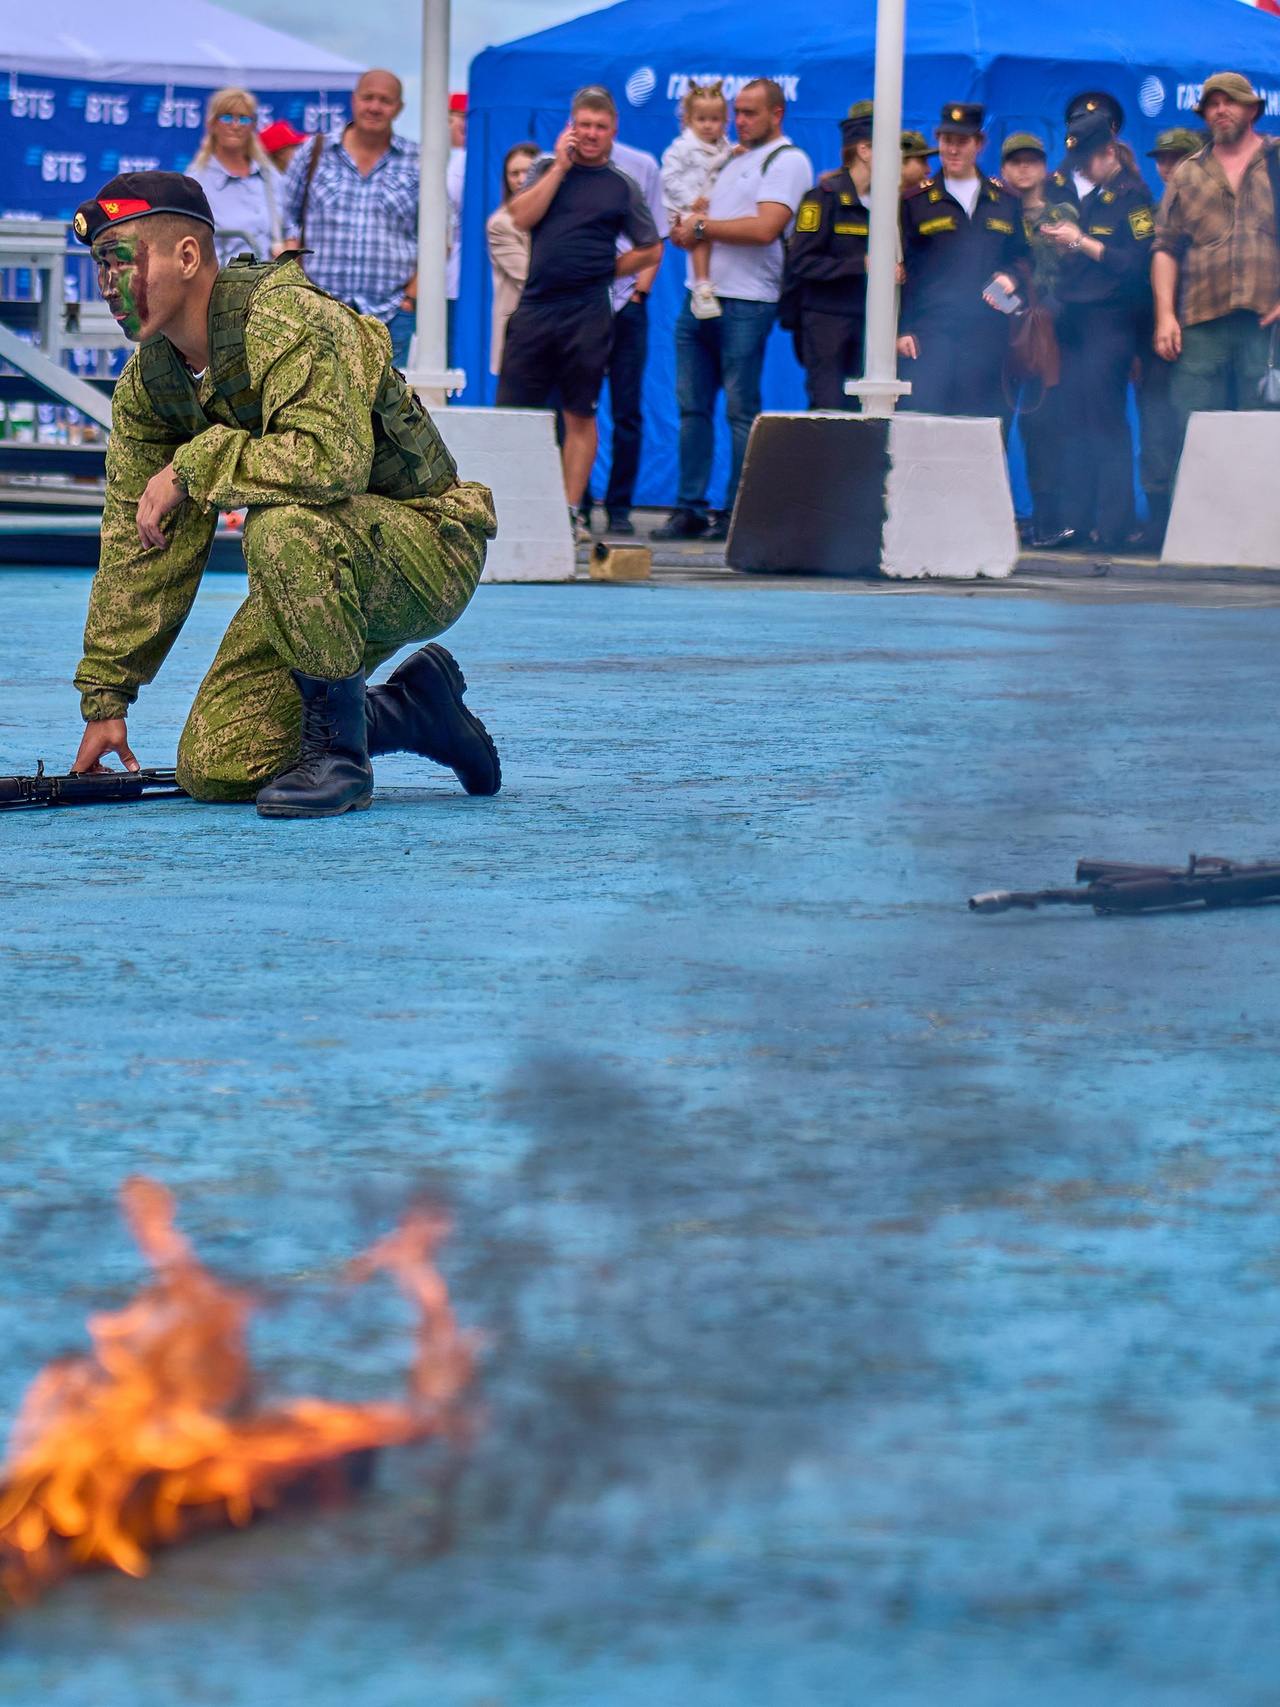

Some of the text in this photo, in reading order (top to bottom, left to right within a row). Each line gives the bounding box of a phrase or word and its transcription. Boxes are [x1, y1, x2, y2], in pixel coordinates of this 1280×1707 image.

[11, 87, 55, 120] ВТБ
[85, 92, 130, 126] ВТБ
[157, 97, 202, 129] ВТБ
[42, 151, 87, 184] ВТБ
